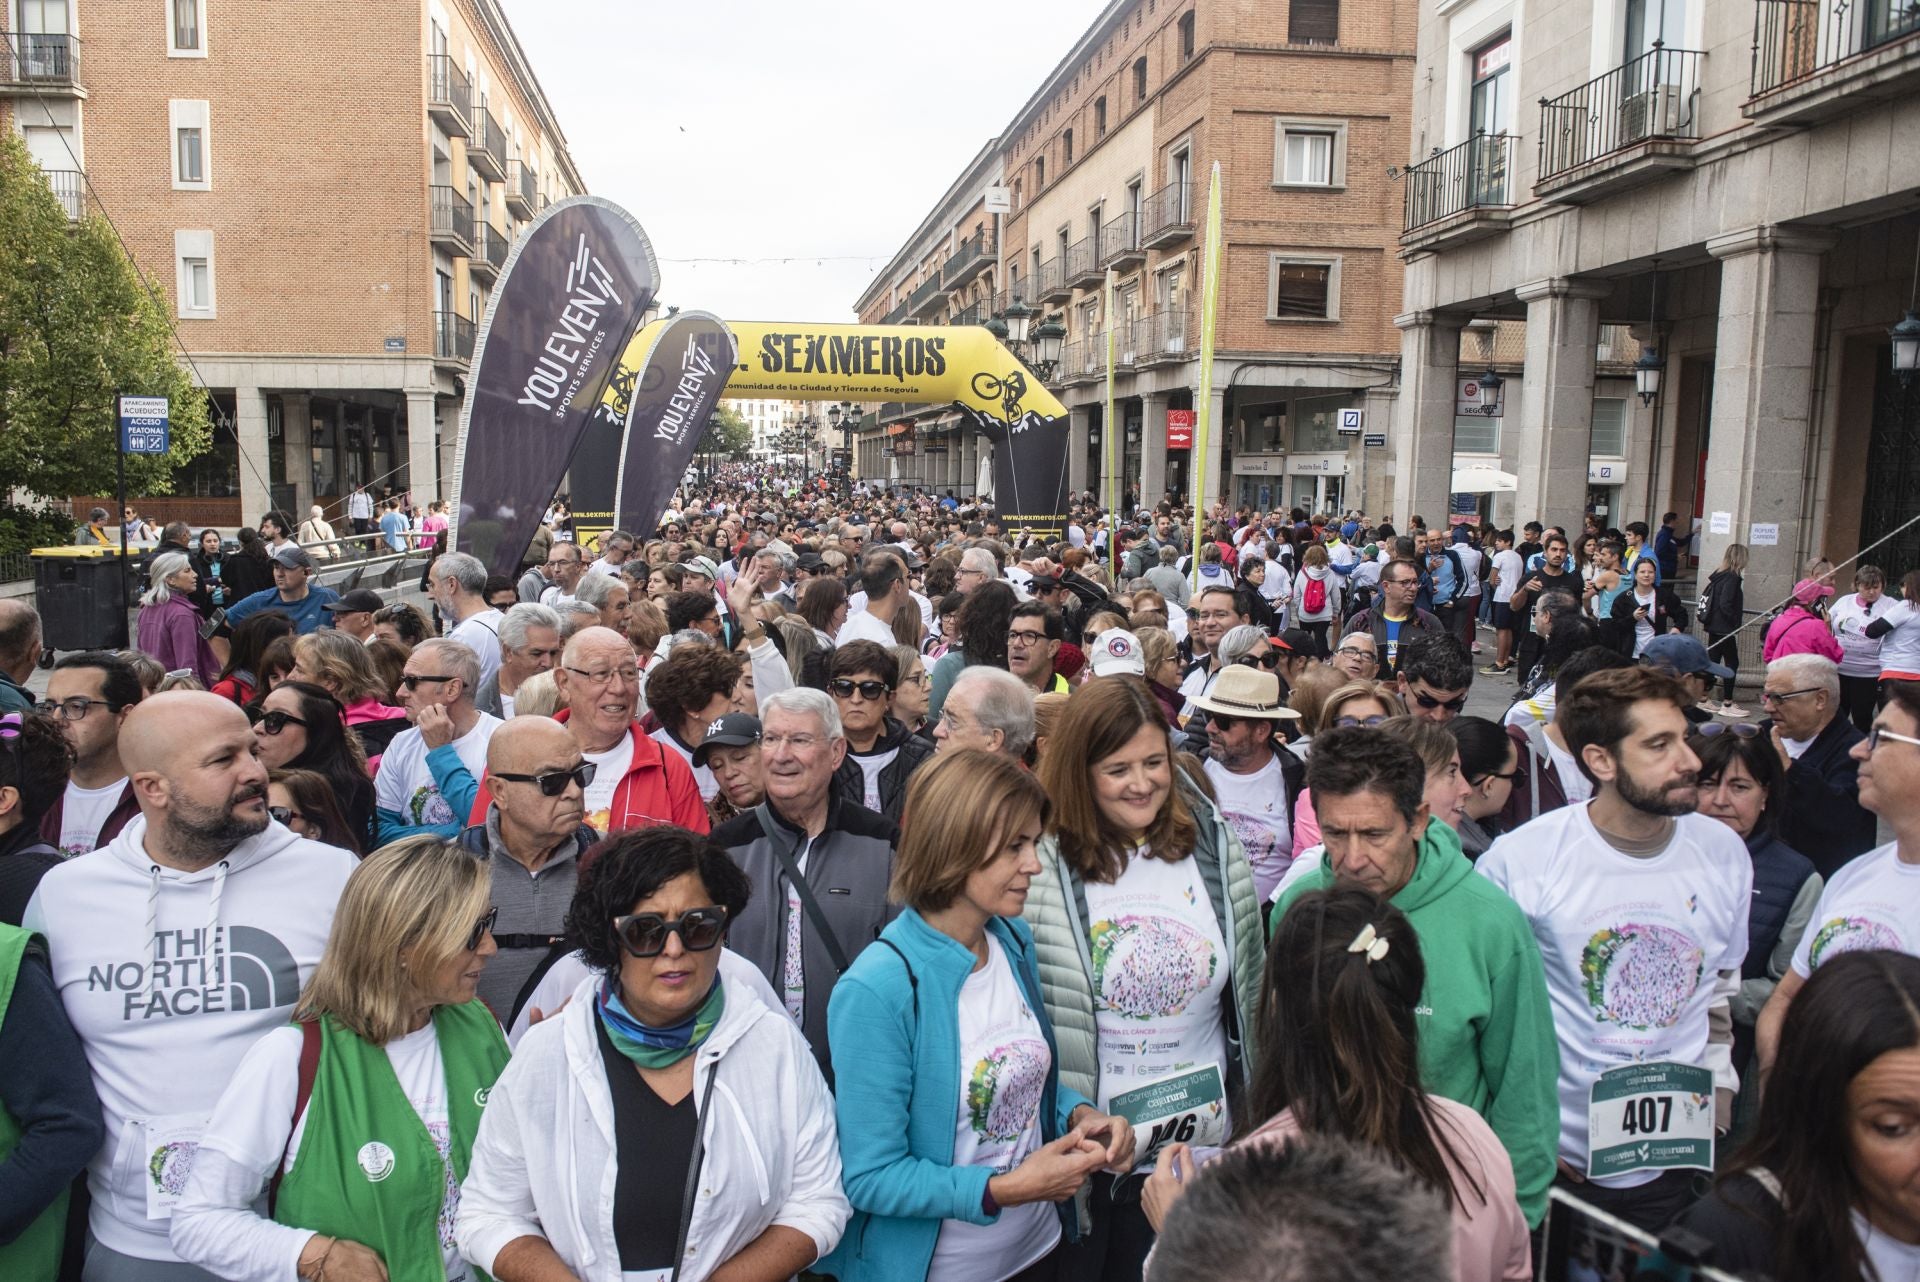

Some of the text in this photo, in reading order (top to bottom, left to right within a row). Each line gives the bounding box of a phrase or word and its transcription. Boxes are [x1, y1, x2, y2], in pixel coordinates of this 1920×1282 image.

[758, 332, 947, 383] SEXMEROS
[556, 330, 606, 419] SPORTS SERVICES
[776, 383, 788, 391] de
[788, 383, 798, 391] la
[800, 383, 832, 393] Ciudad
[841, 384, 869, 394] Tierra
[870, 385, 882, 394] de
[884, 385, 919, 395] Segovia
[124, 407, 167, 415] ACUEDUCTO
[130, 418, 162, 426] ACCESO
[676, 391, 707, 446] SPORTS SERVICES
[127, 426, 165, 435] PEATONAL
[154, 926, 224, 959] THE
[88, 955, 225, 992] NORTH
[123, 987, 226, 1020] FACE
[1414, 1004, 1433, 1016] ola
[1127, 1088, 1158, 1105] Carrera
[1158, 1079, 1189, 1097] popular
[1189, 1074, 1199, 1085] 10
[1625, 1072, 1667, 1087] cajarural
[1147, 1088, 1189, 1109] cajarural
[1621, 1095, 1673, 1136] 407
[1651, 1144, 1695, 1157] cajarural
